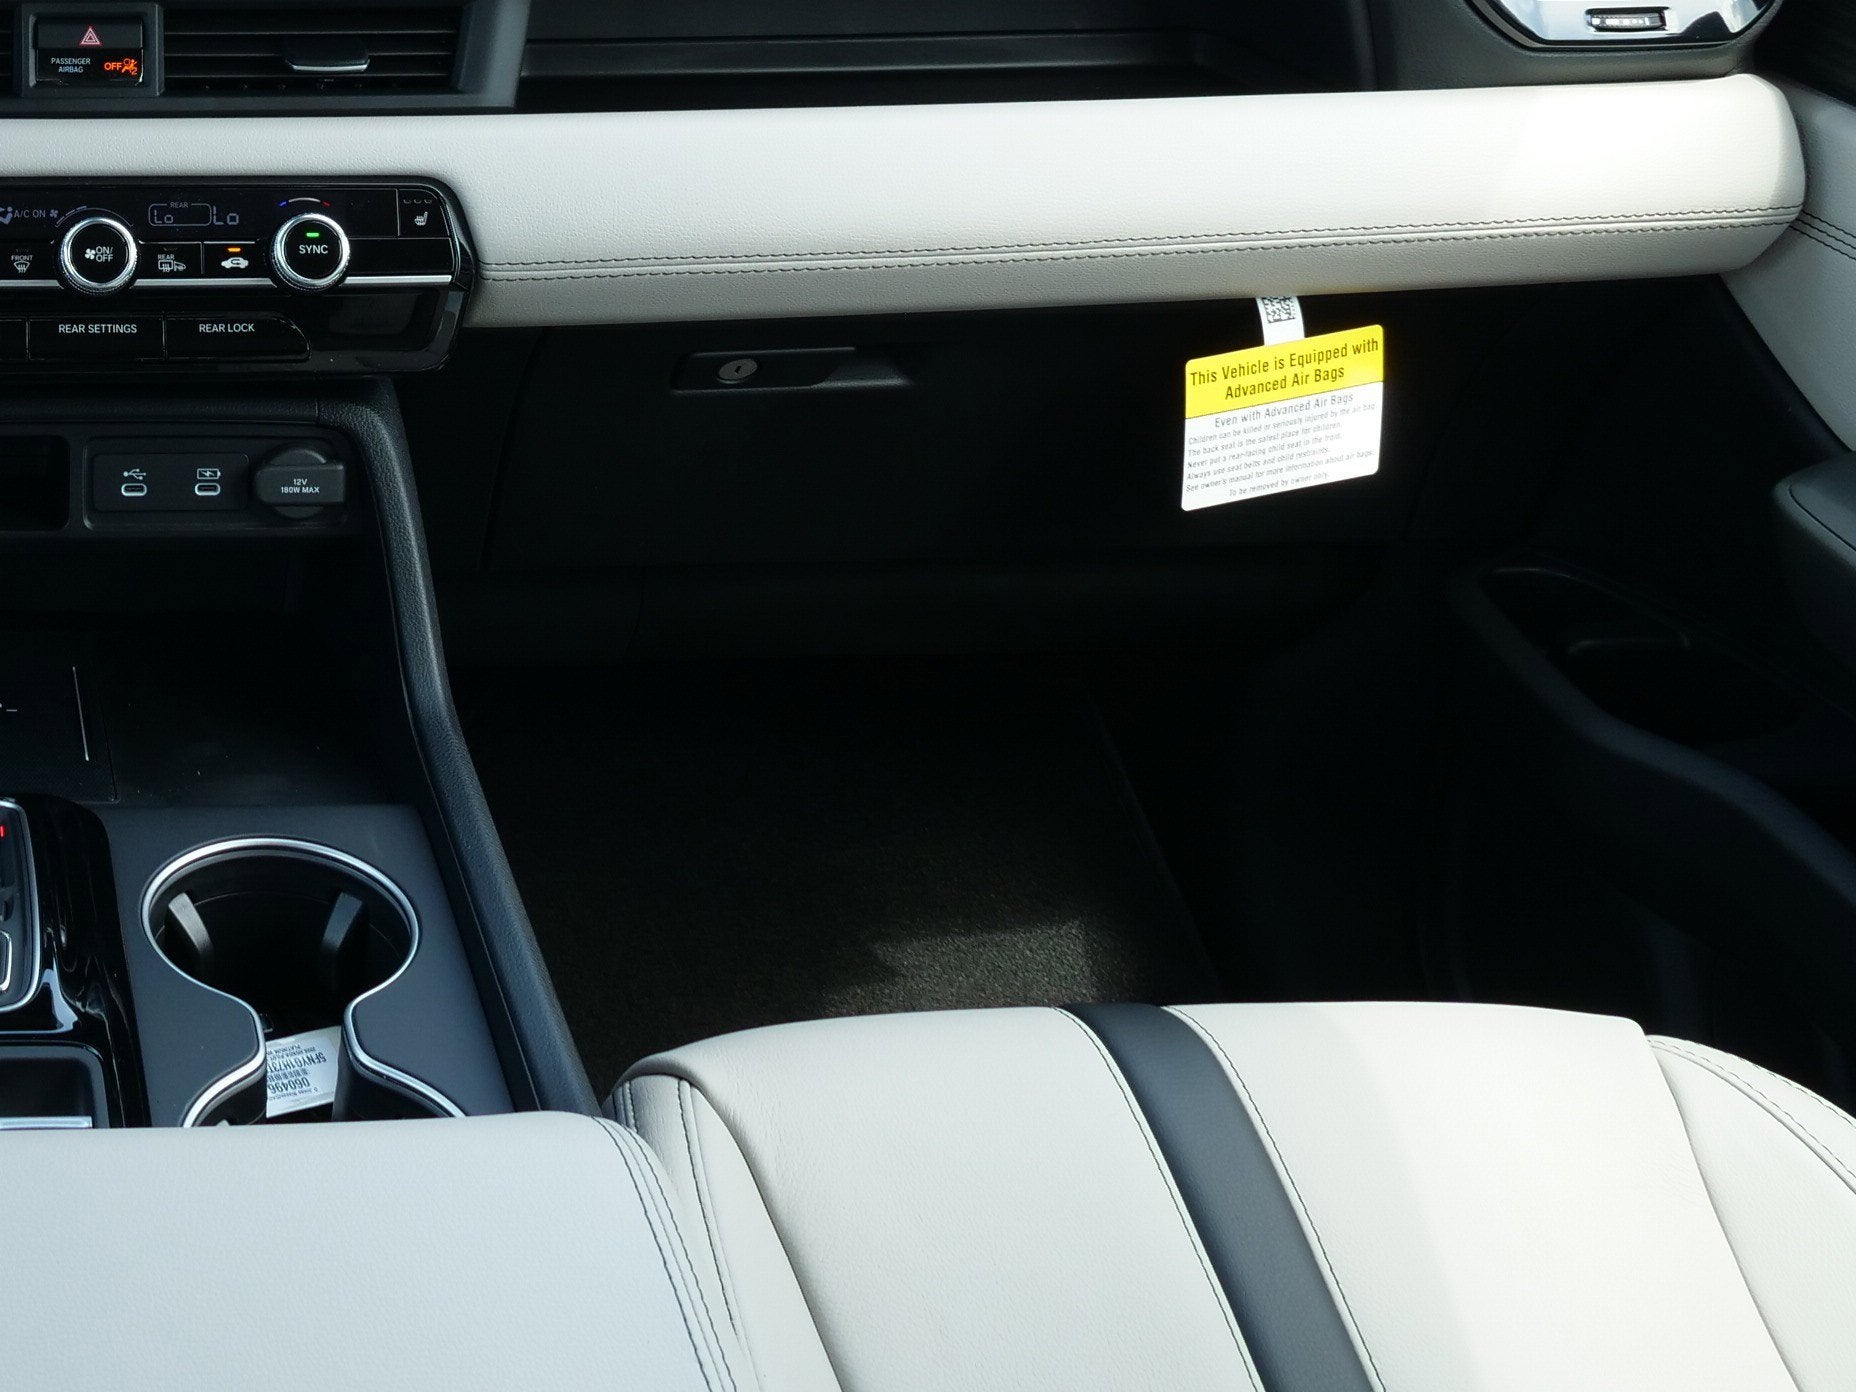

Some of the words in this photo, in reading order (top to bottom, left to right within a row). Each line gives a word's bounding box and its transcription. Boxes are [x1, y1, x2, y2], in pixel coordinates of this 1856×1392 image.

[50, 57, 91, 65] PASSENGER
[58, 65, 84, 73] AIRBAG
[103, 62, 123, 71] OFF
[169, 201, 189, 209] REAR
[13, 209, 30, 219] A/C
[32, 208, 46, 219] ON
[298, 244, 329, 255] SYNC
[10, 254, 33, 262] FRONT
[95, 253, 114, 263] OFF
[157, 253, 175, 261] REAR
[58, 323, 86, 334] REAR
[87, 323, 138, 334] SETTINGS
[198, 323, 226, 333] REAR
[227, 323, 255, 333] LOCK
[1190, 369, 1217, 386] This
[1222, 360, 1269, 380] Vehicle
[1274, 357, 1285, 371] is
[1289, 344, 1347, 366] Equipped
[1352, 338, 1379, 355] with
[1225, 375, 1287, 400] Advanced
[1291, 372, 1309, 392] Air
[1314, 366, 1345, 385] Bags
[1215, 416, 1237, 428] Even
[1241, 411, 1261, 422] with
[1264, 401, 1311, 418] Advanced
[1314, 398, 1327, 409] Air
[1331, 393, 1353, 405] Bags
[293, 478, 308, 486] 12V
[280, 486, 301, 494] 180W
[301, 486, 320, 494] MAX
[267, 1077, 311, 1094] 060496
